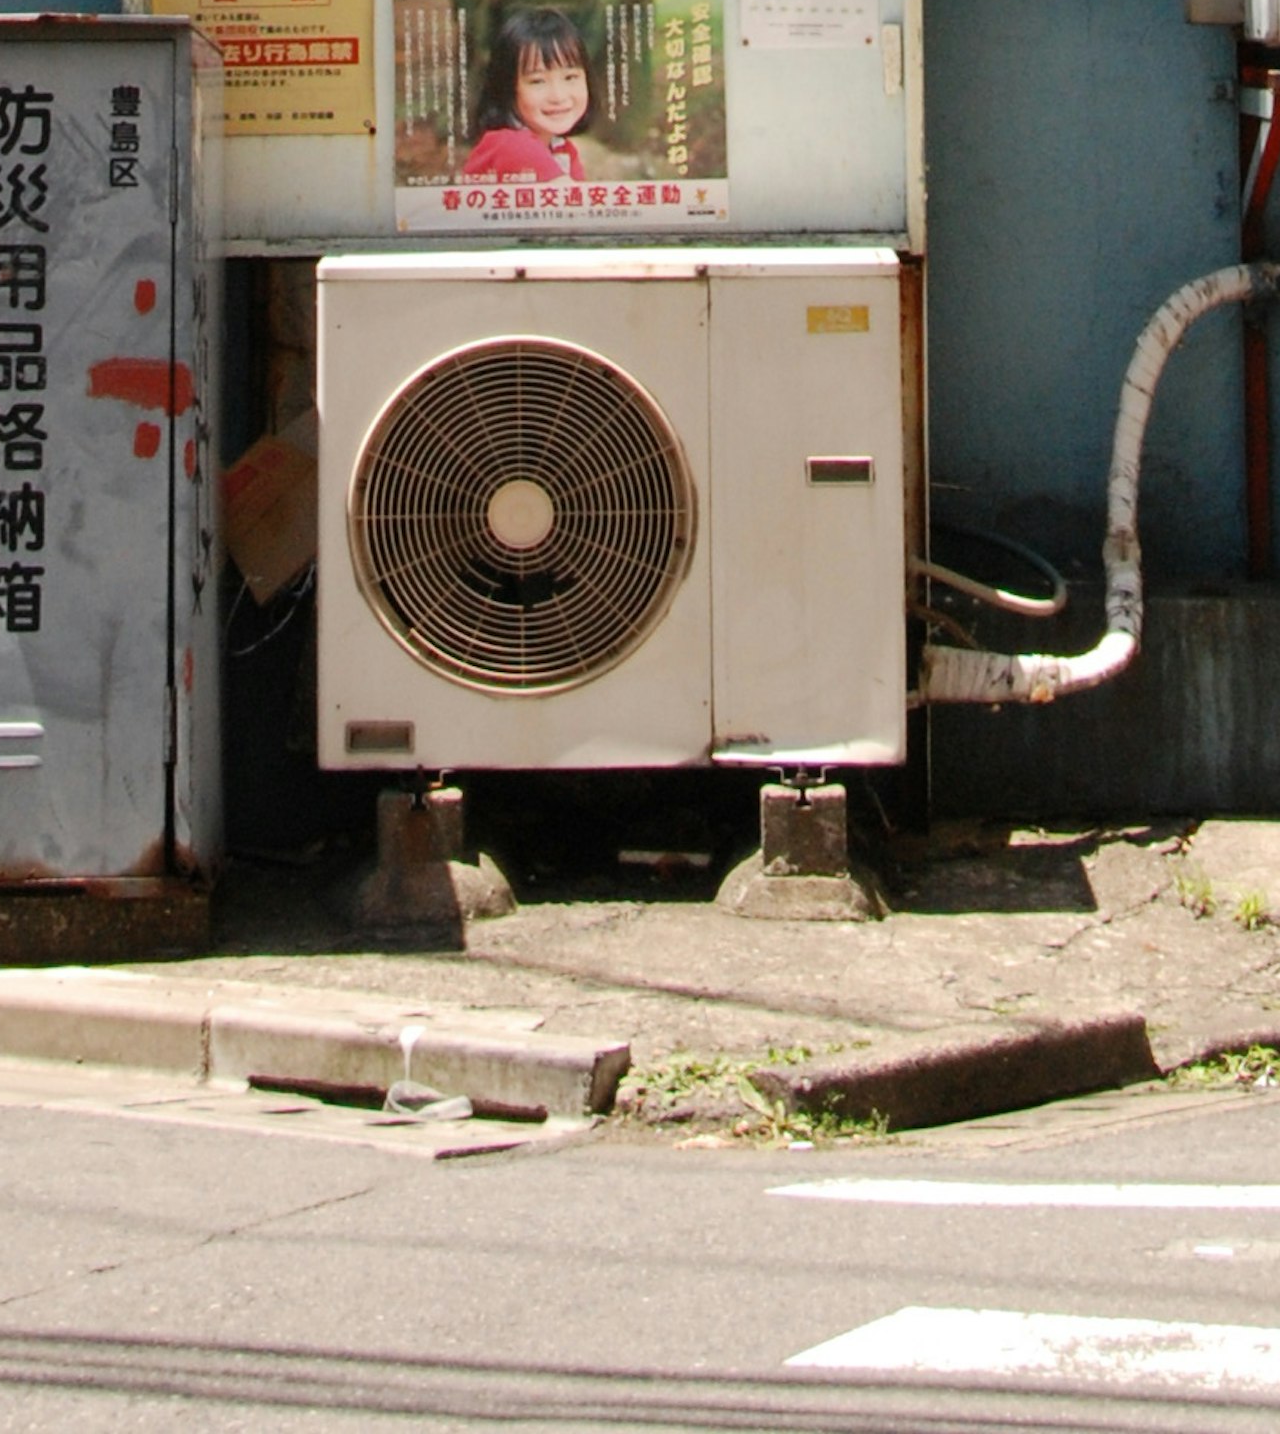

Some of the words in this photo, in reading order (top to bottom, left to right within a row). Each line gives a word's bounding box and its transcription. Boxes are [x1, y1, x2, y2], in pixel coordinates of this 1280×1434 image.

[691, 2, 713, 88] 安全確認
[108, 86, 142, 189] 豊島区
[665, 17, 689, 176] 大切なんだよね。
[442, 184, 682, 211] 春の全国交通安全運動
